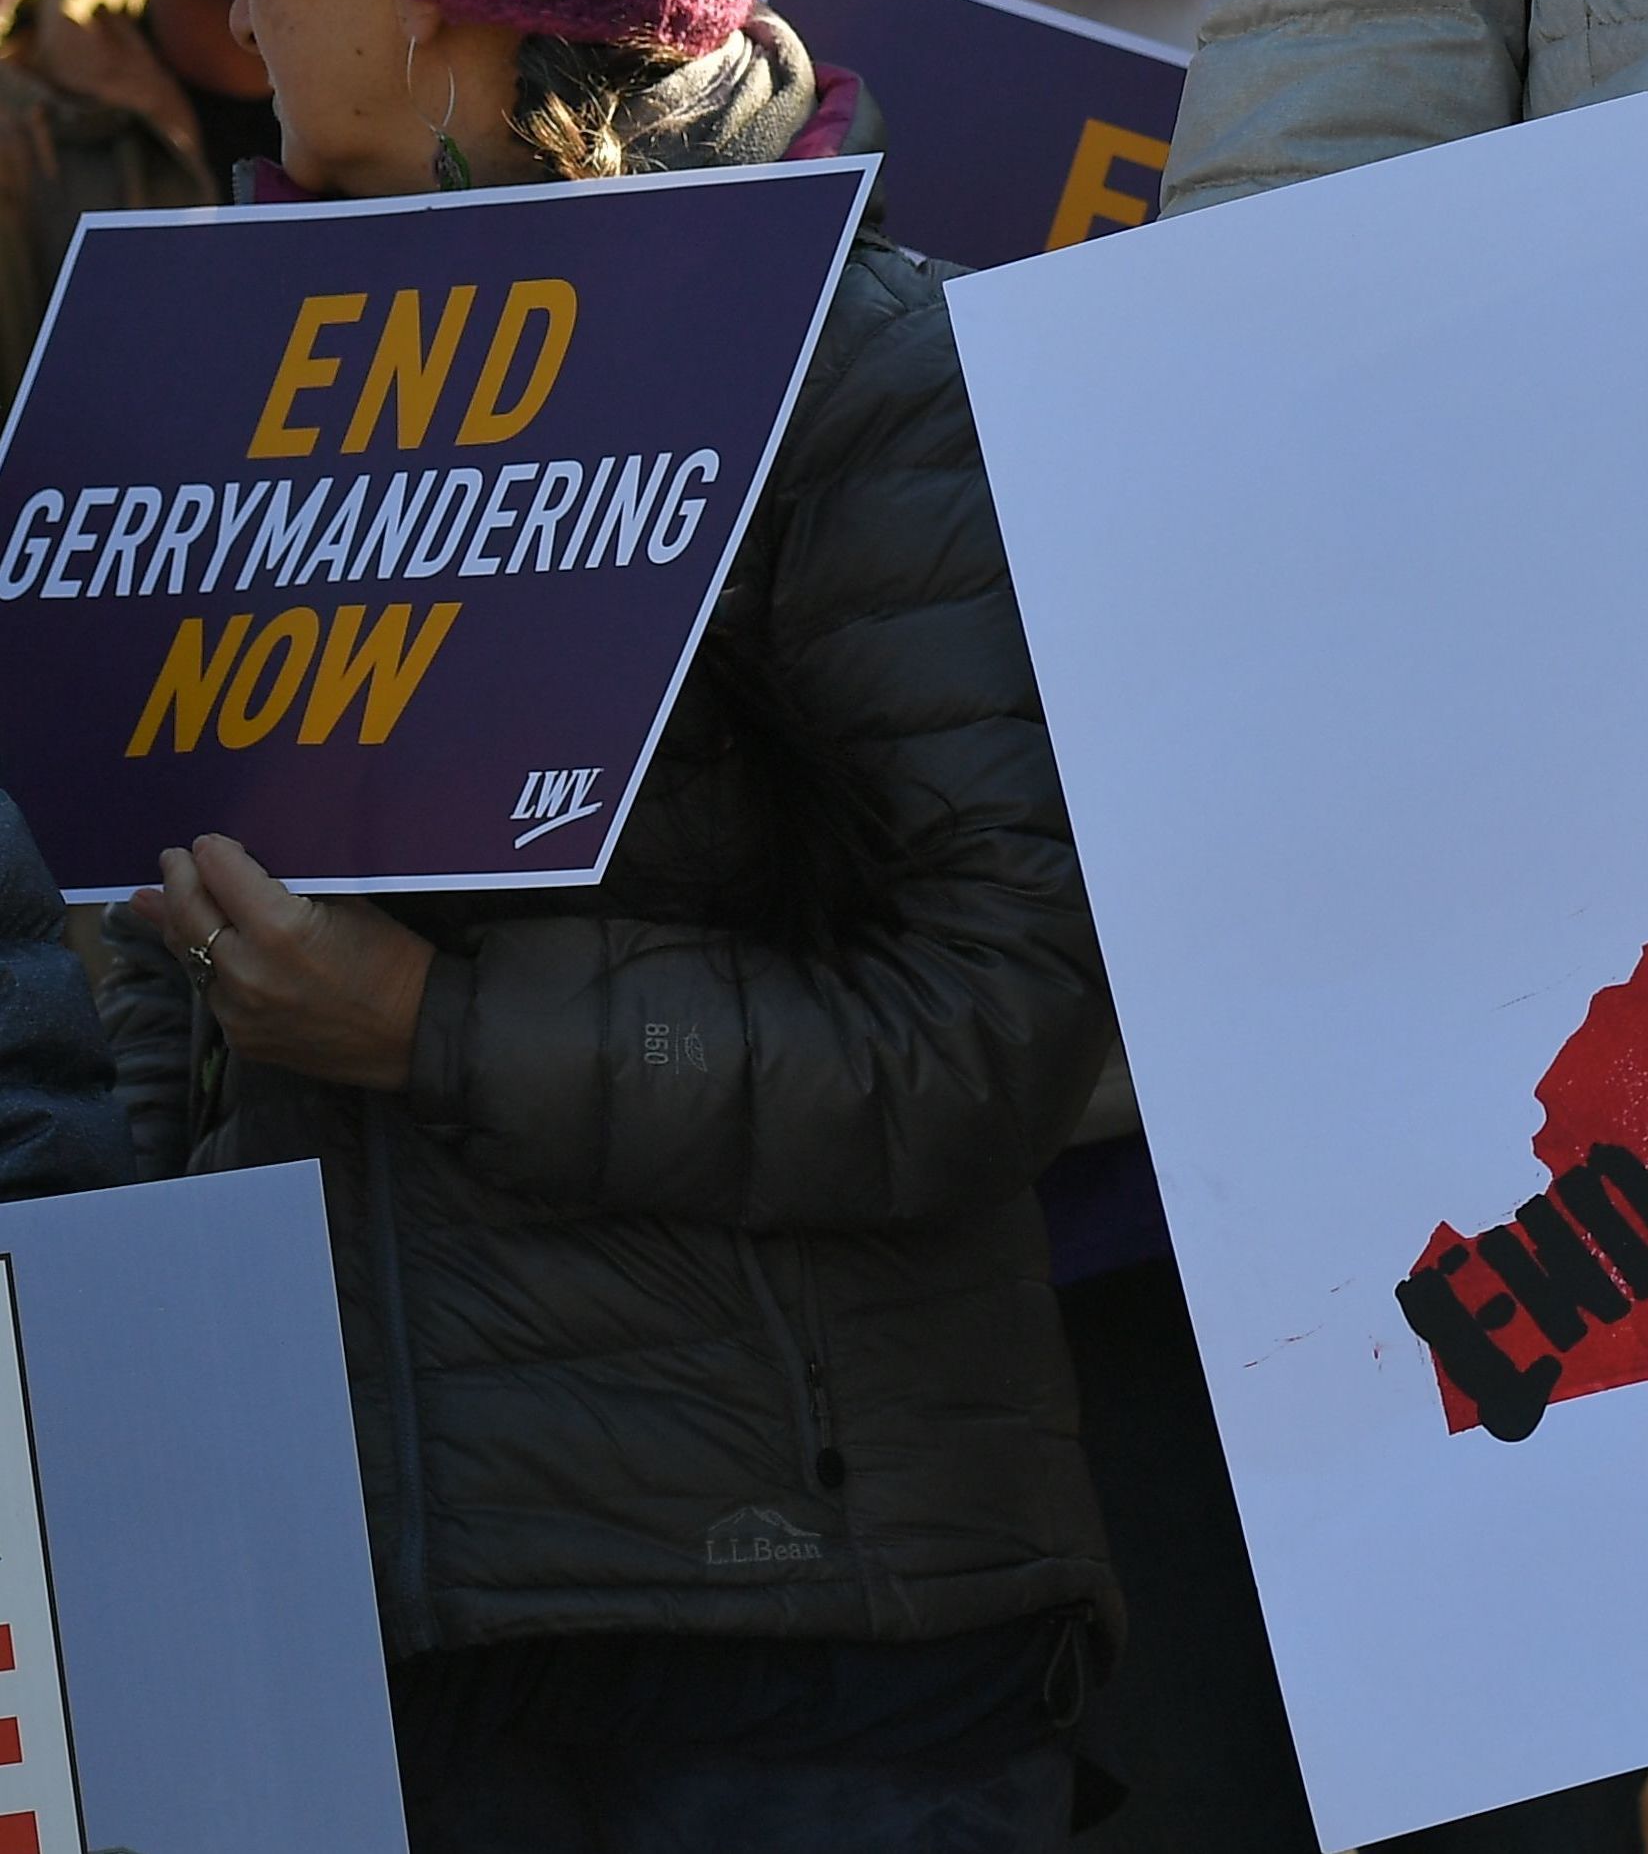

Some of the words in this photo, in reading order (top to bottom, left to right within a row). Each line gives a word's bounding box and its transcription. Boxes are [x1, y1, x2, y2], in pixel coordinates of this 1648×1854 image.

[246, 278, 579, 460] END
[0, 447, 721, 601] GERRYMANDERING
[124, 602, 463, 758] NOW
[509, 767, 605, 820] LWV
